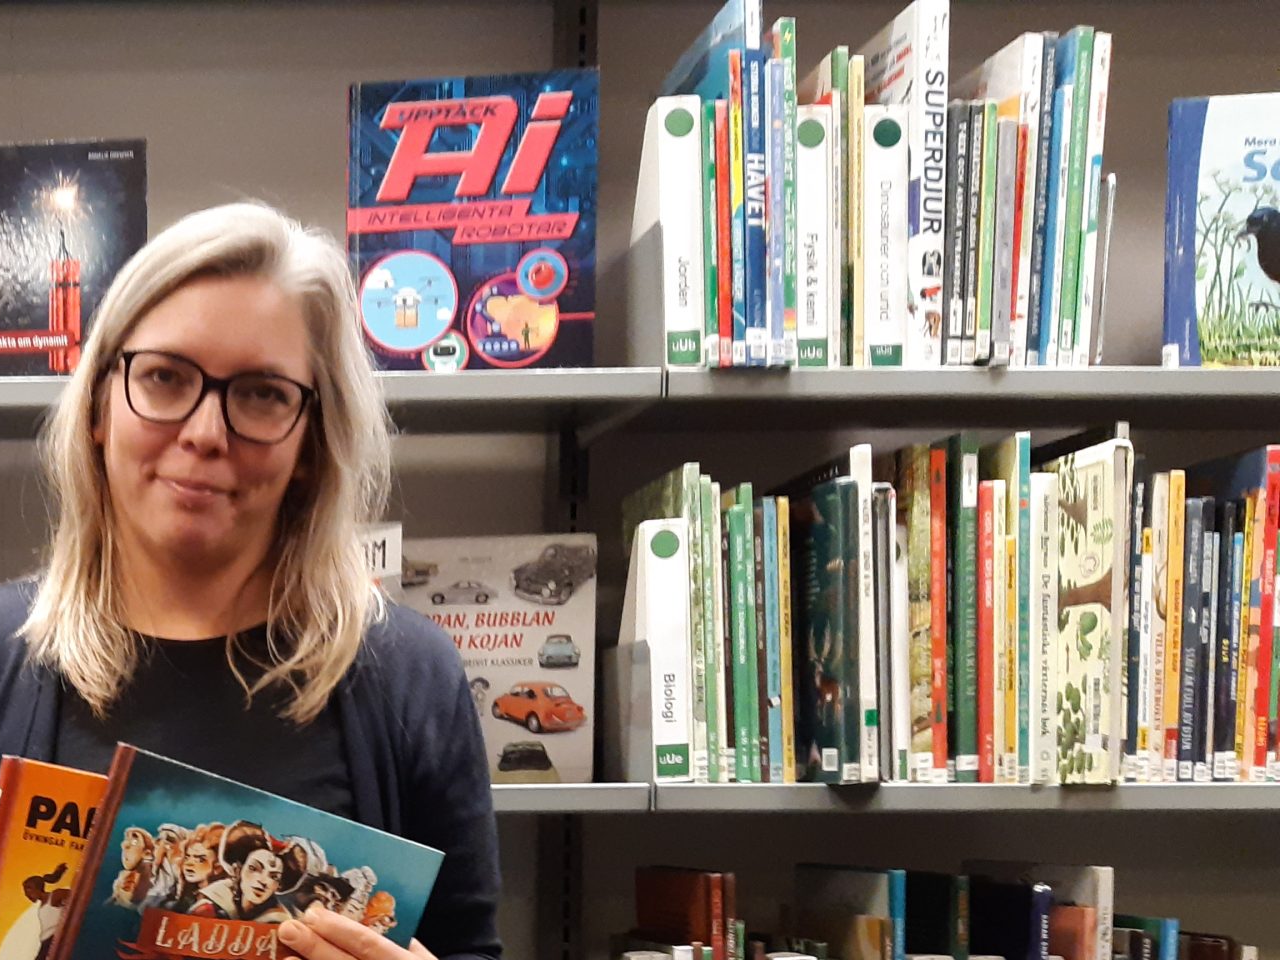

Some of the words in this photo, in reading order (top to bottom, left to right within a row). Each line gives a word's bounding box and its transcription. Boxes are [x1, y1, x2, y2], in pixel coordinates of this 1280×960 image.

[398, 102, 501, 124] UPPTÄCK
[923, 69, 944, 235] SUPERDJUR
[747, 153, 767, 231] HAVET
[367, 203, 514, 226] INTELLIGENTA
[460, 222, 568, 240] ROBOTAR
[804, 232, 820, 270] Fysik
[676, 256, 691, 309] Jorden
[806, 275, 818, 287] &
[806, 291, 819, 327] kemi
[17, 338, 31, 347] om
[32, 336, 68, 350] dynamit
[473, 610, 556, 630] BUBBLAN
[466, 634, 525, 652] KOJAN
[661, 673, 677, 724] Biologi
